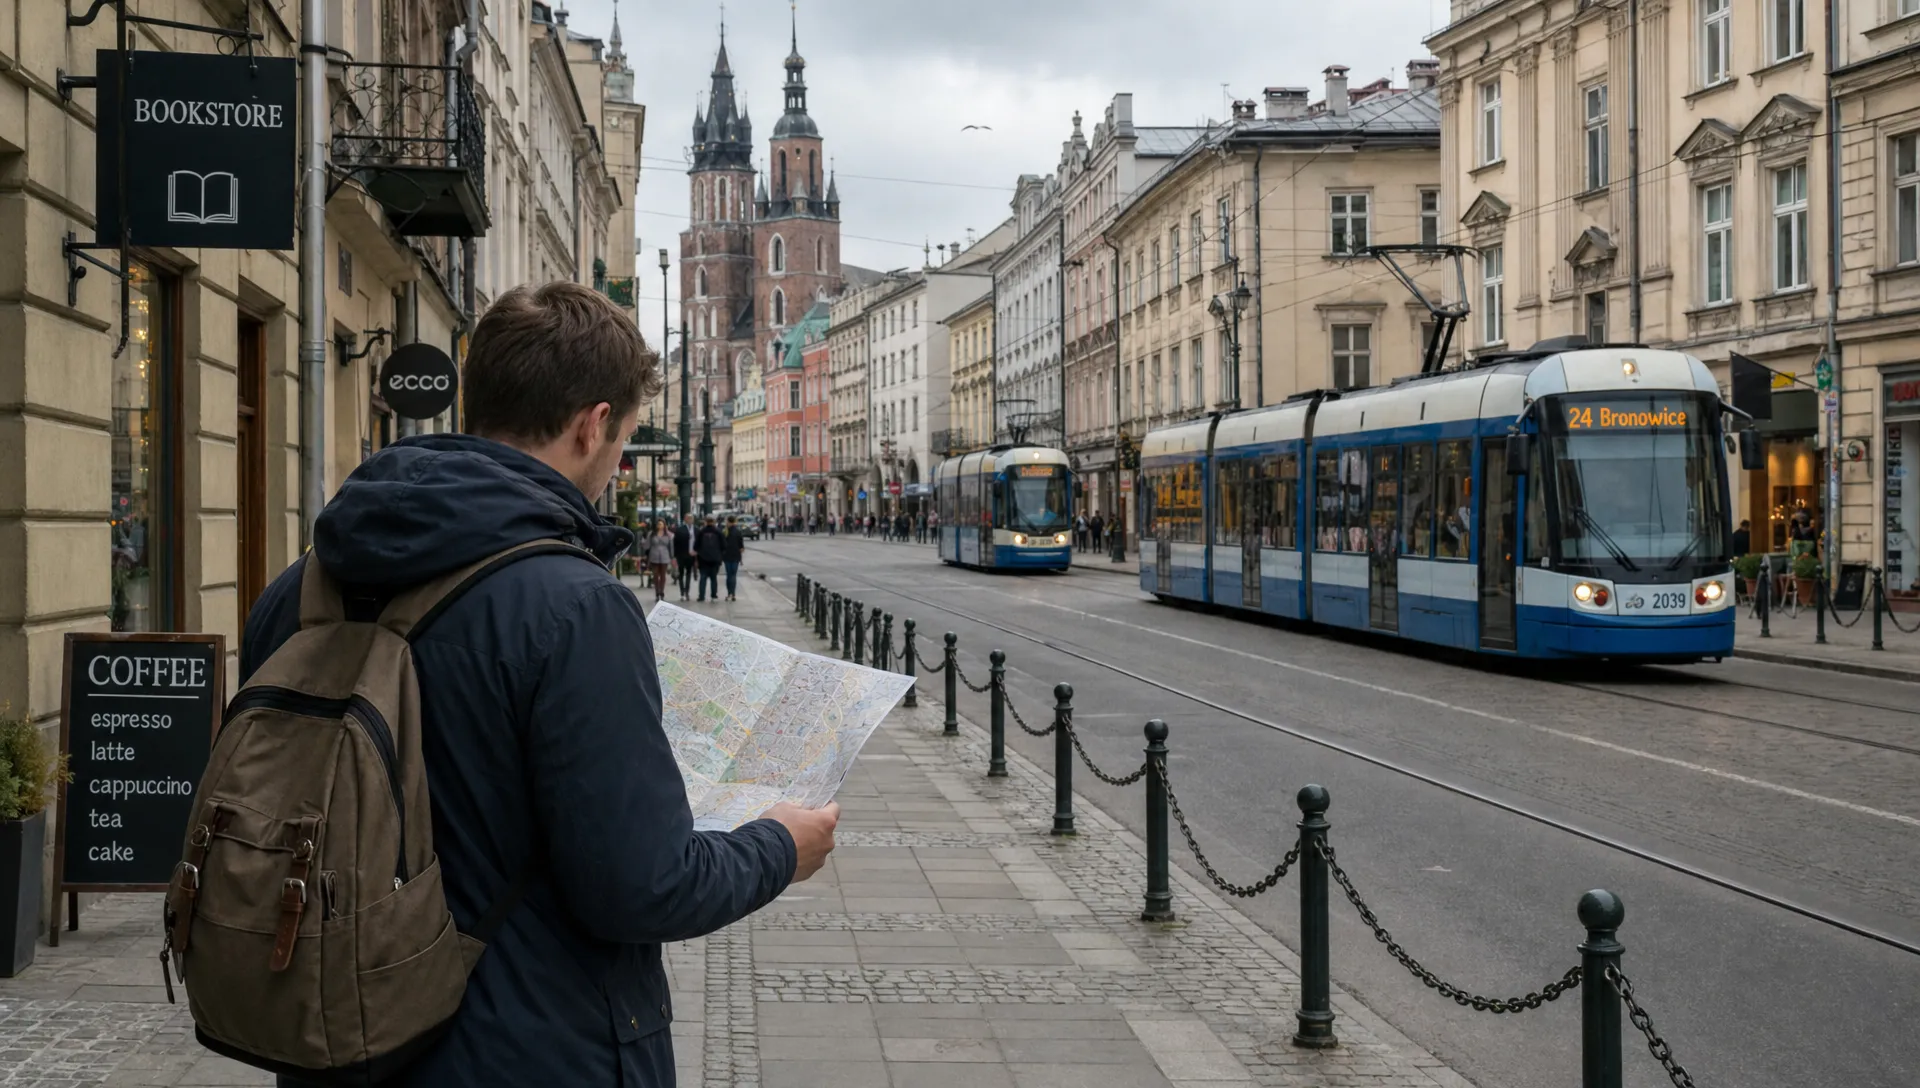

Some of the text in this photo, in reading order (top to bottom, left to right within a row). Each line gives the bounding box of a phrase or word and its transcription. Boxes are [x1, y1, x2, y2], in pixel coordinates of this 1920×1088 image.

[134, 98, 283, 128] BOOKSTORE
[389, 375, 450, 391] ecco
[1569, 407, 1686, 429] 24 Bronowice
[1652, 592, 1686, 609] 2039
[88, 656, 206, 687] COFFEE
[90, 712, 172, 734] espresso
[91, 741, 136, 761] latte
[89, 776, 192, 800] cappuccino
[88, 809, 123, 828] tea
[88, 841, 134, 861] cake
